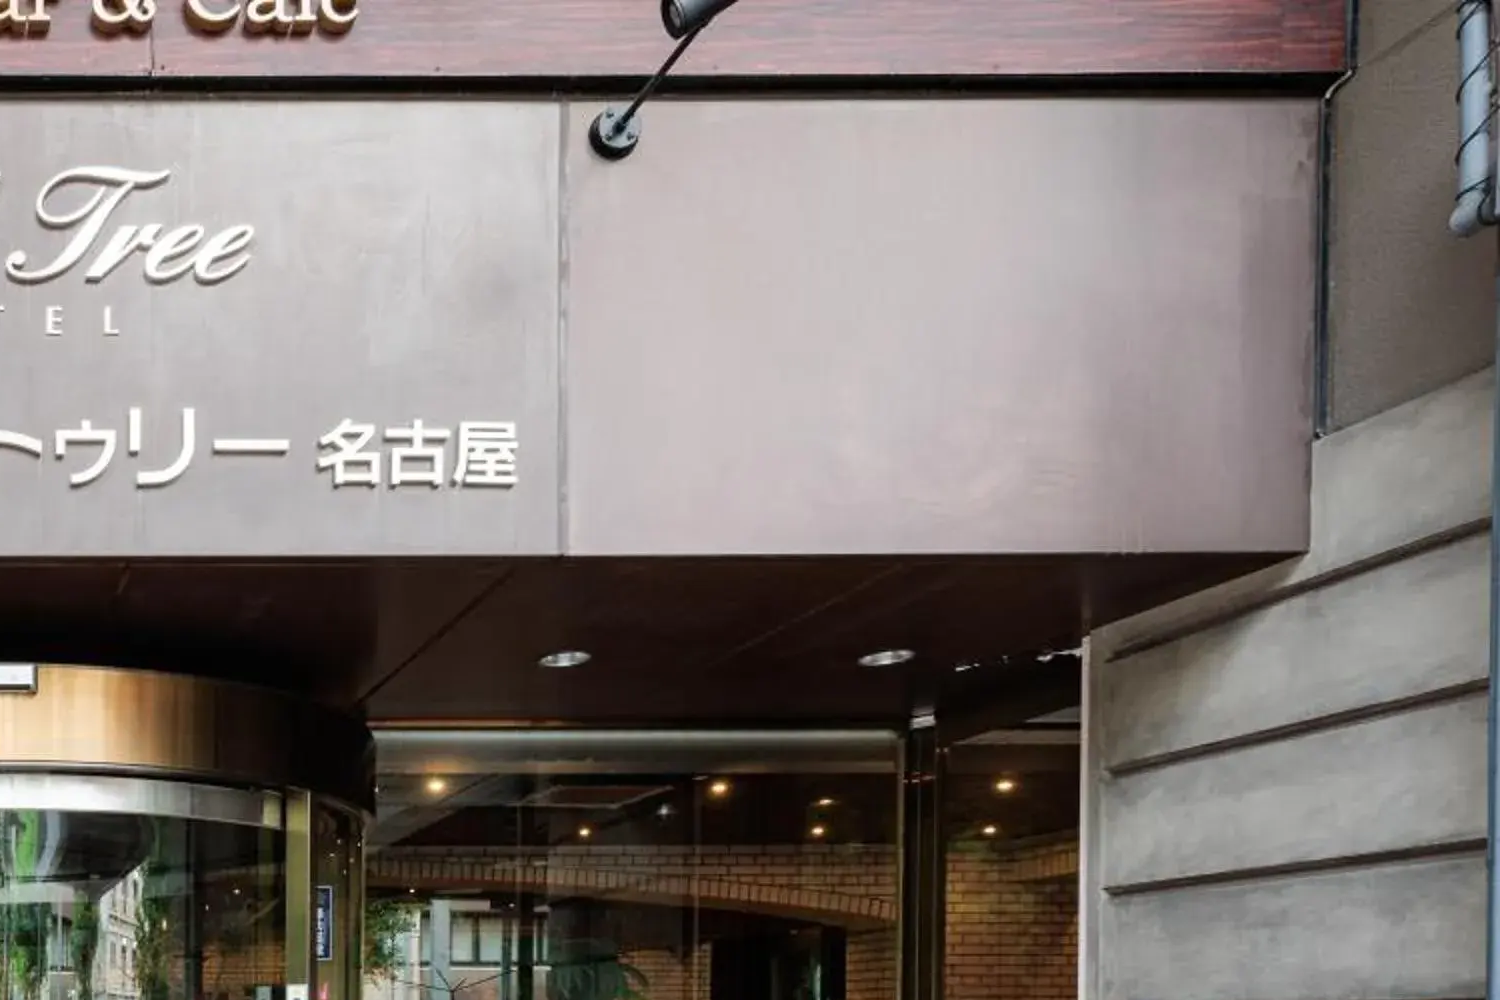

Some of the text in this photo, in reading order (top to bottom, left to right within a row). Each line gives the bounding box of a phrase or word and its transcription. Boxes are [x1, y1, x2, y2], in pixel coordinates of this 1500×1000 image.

[4, 165, 255, 285] Tree
[316, 418, 519, 488] 名古屋
